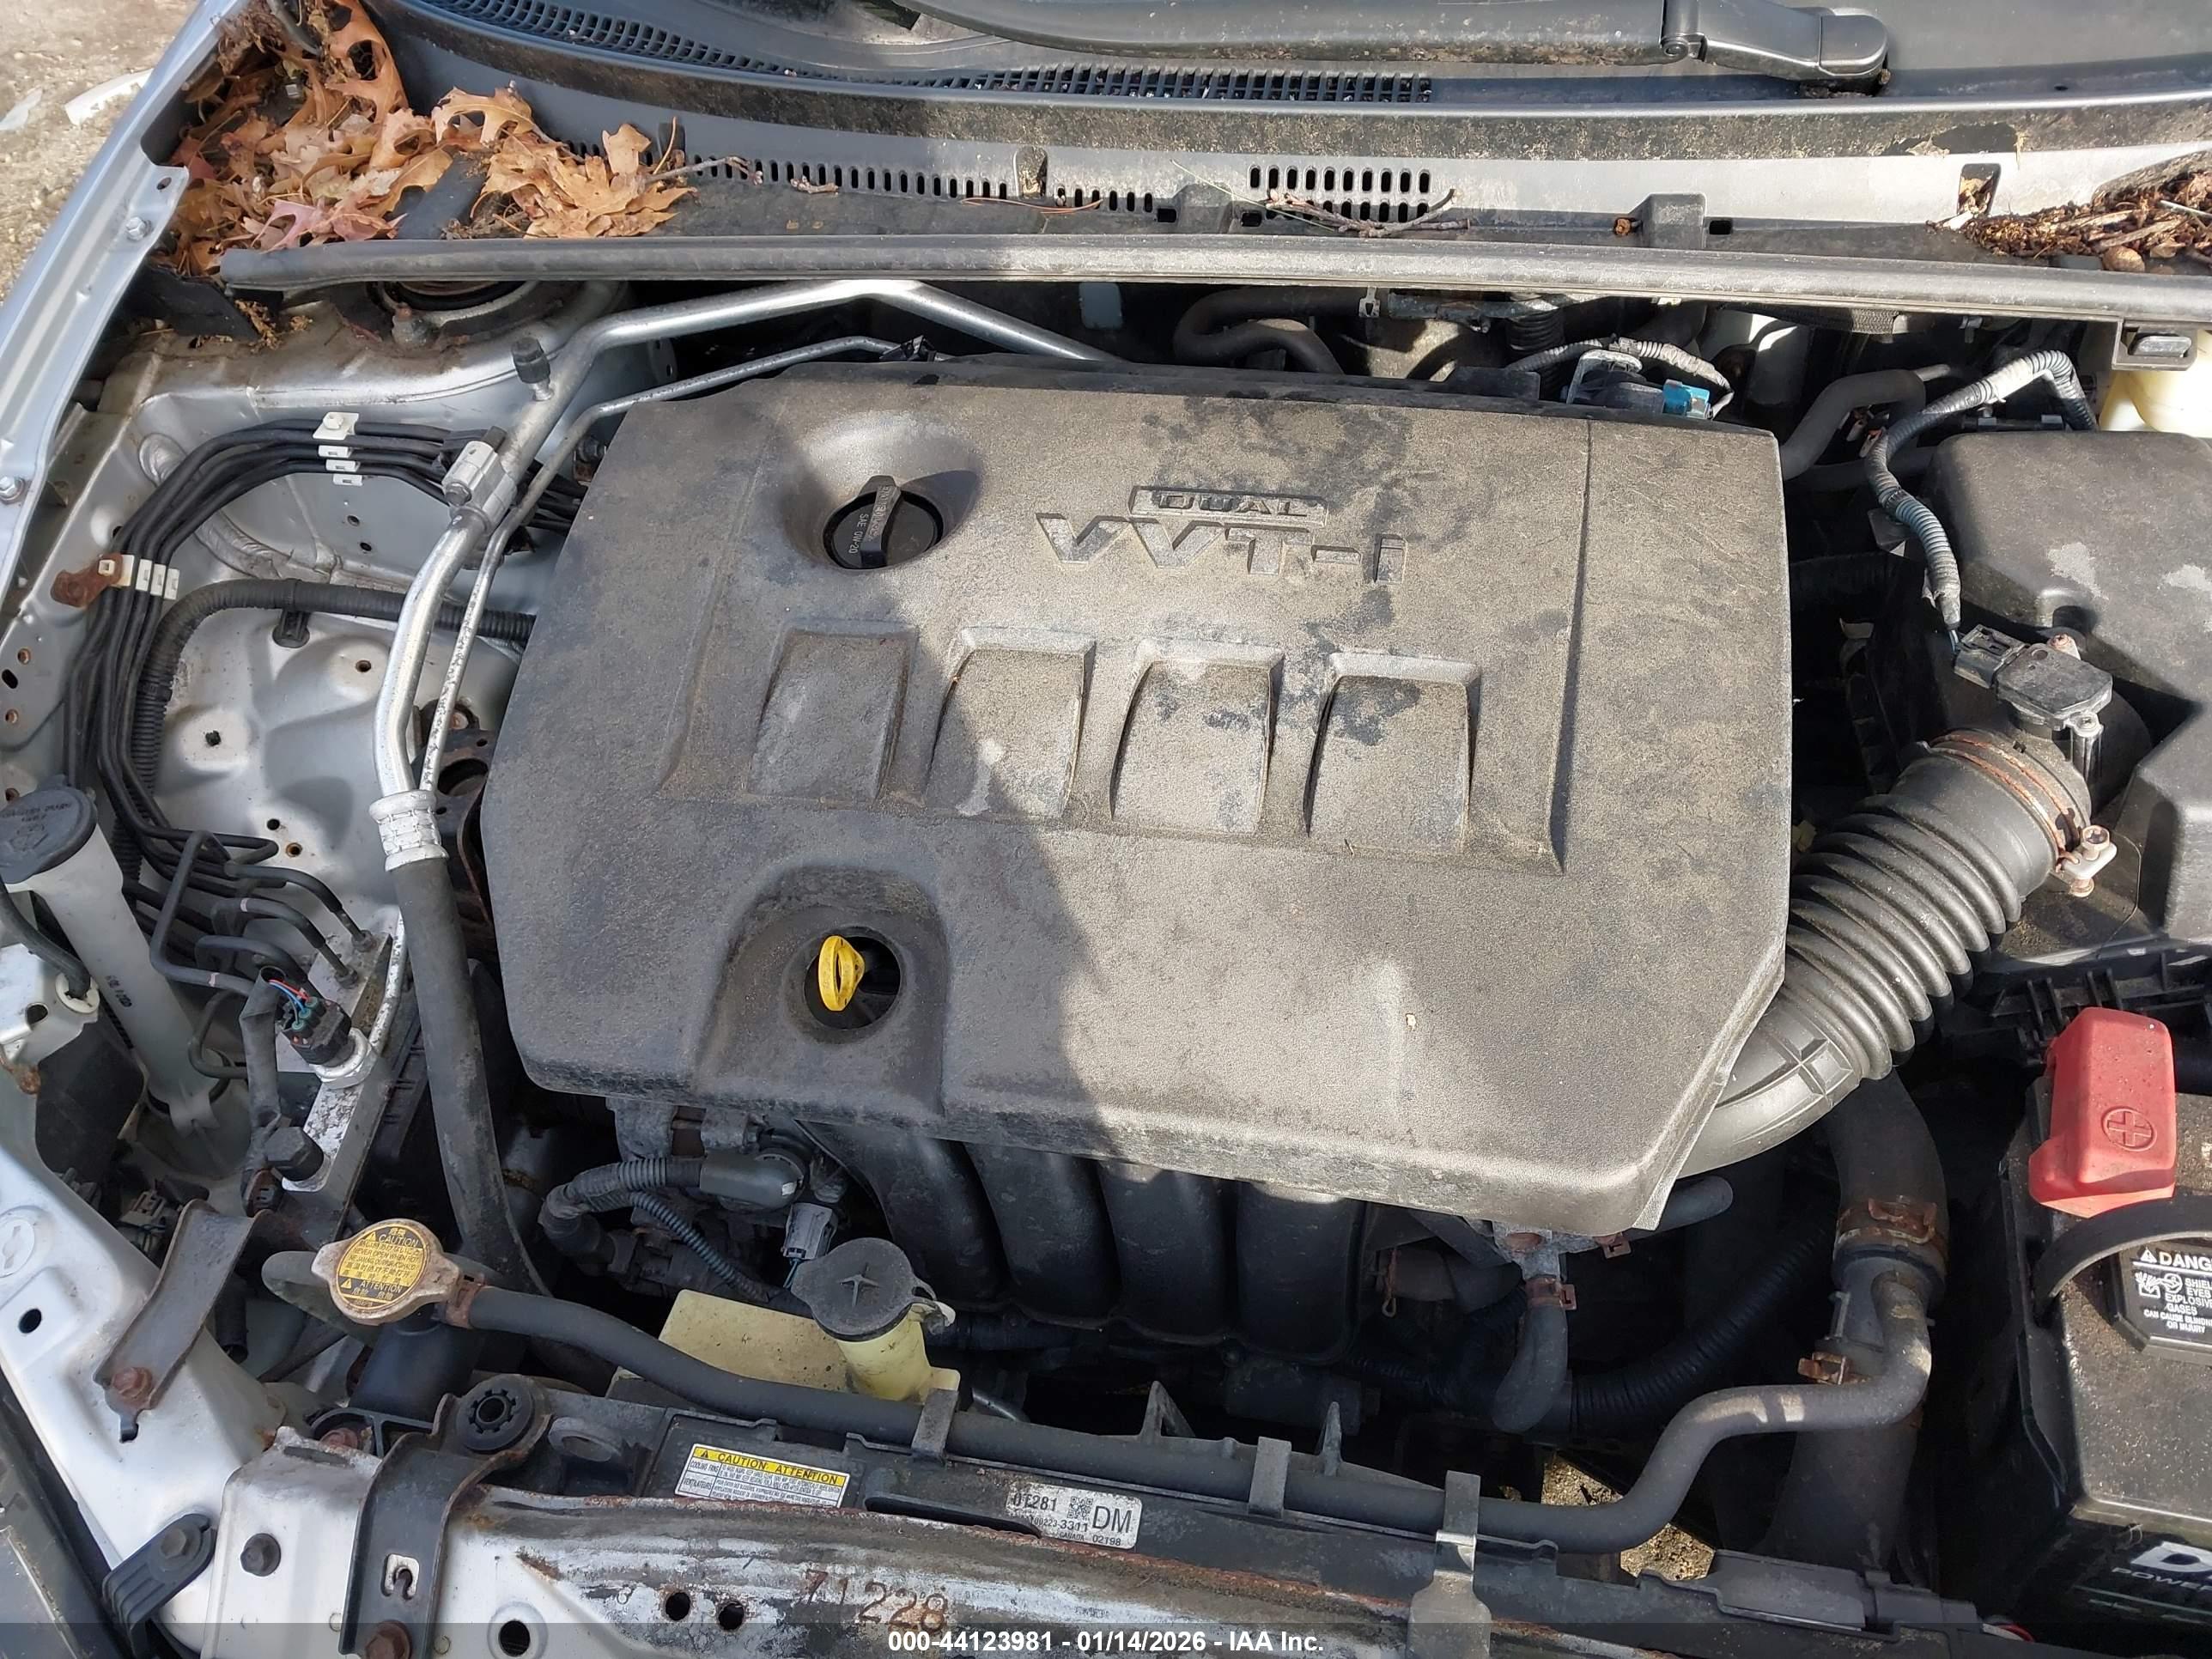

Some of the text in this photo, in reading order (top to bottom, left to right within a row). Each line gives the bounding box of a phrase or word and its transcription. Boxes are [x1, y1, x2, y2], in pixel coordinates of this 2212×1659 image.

[1158, 494, 1308, 517] DUAL
[848, 513, 869, 554] SAE 0W-20
[379, 1234, 419, 1248] CAUTION
[2159, 1251, 2212, 1271] DANG
[360, 1279, 403, 1293] ATTENTION
[2186, 1287, 2211, 1299] EYES
[2143, 1310, 2159, 1318] CAN
[2160, 1311, 2184, 1322] CAUSE
[2166, 1303, 2198, 1316] GASES
[2166, 1321, 2205, 1334] OR INJURY
[775, 1464, 838, 1485] ATTENTION
[1092, 1505, 1133, 1534] DM
